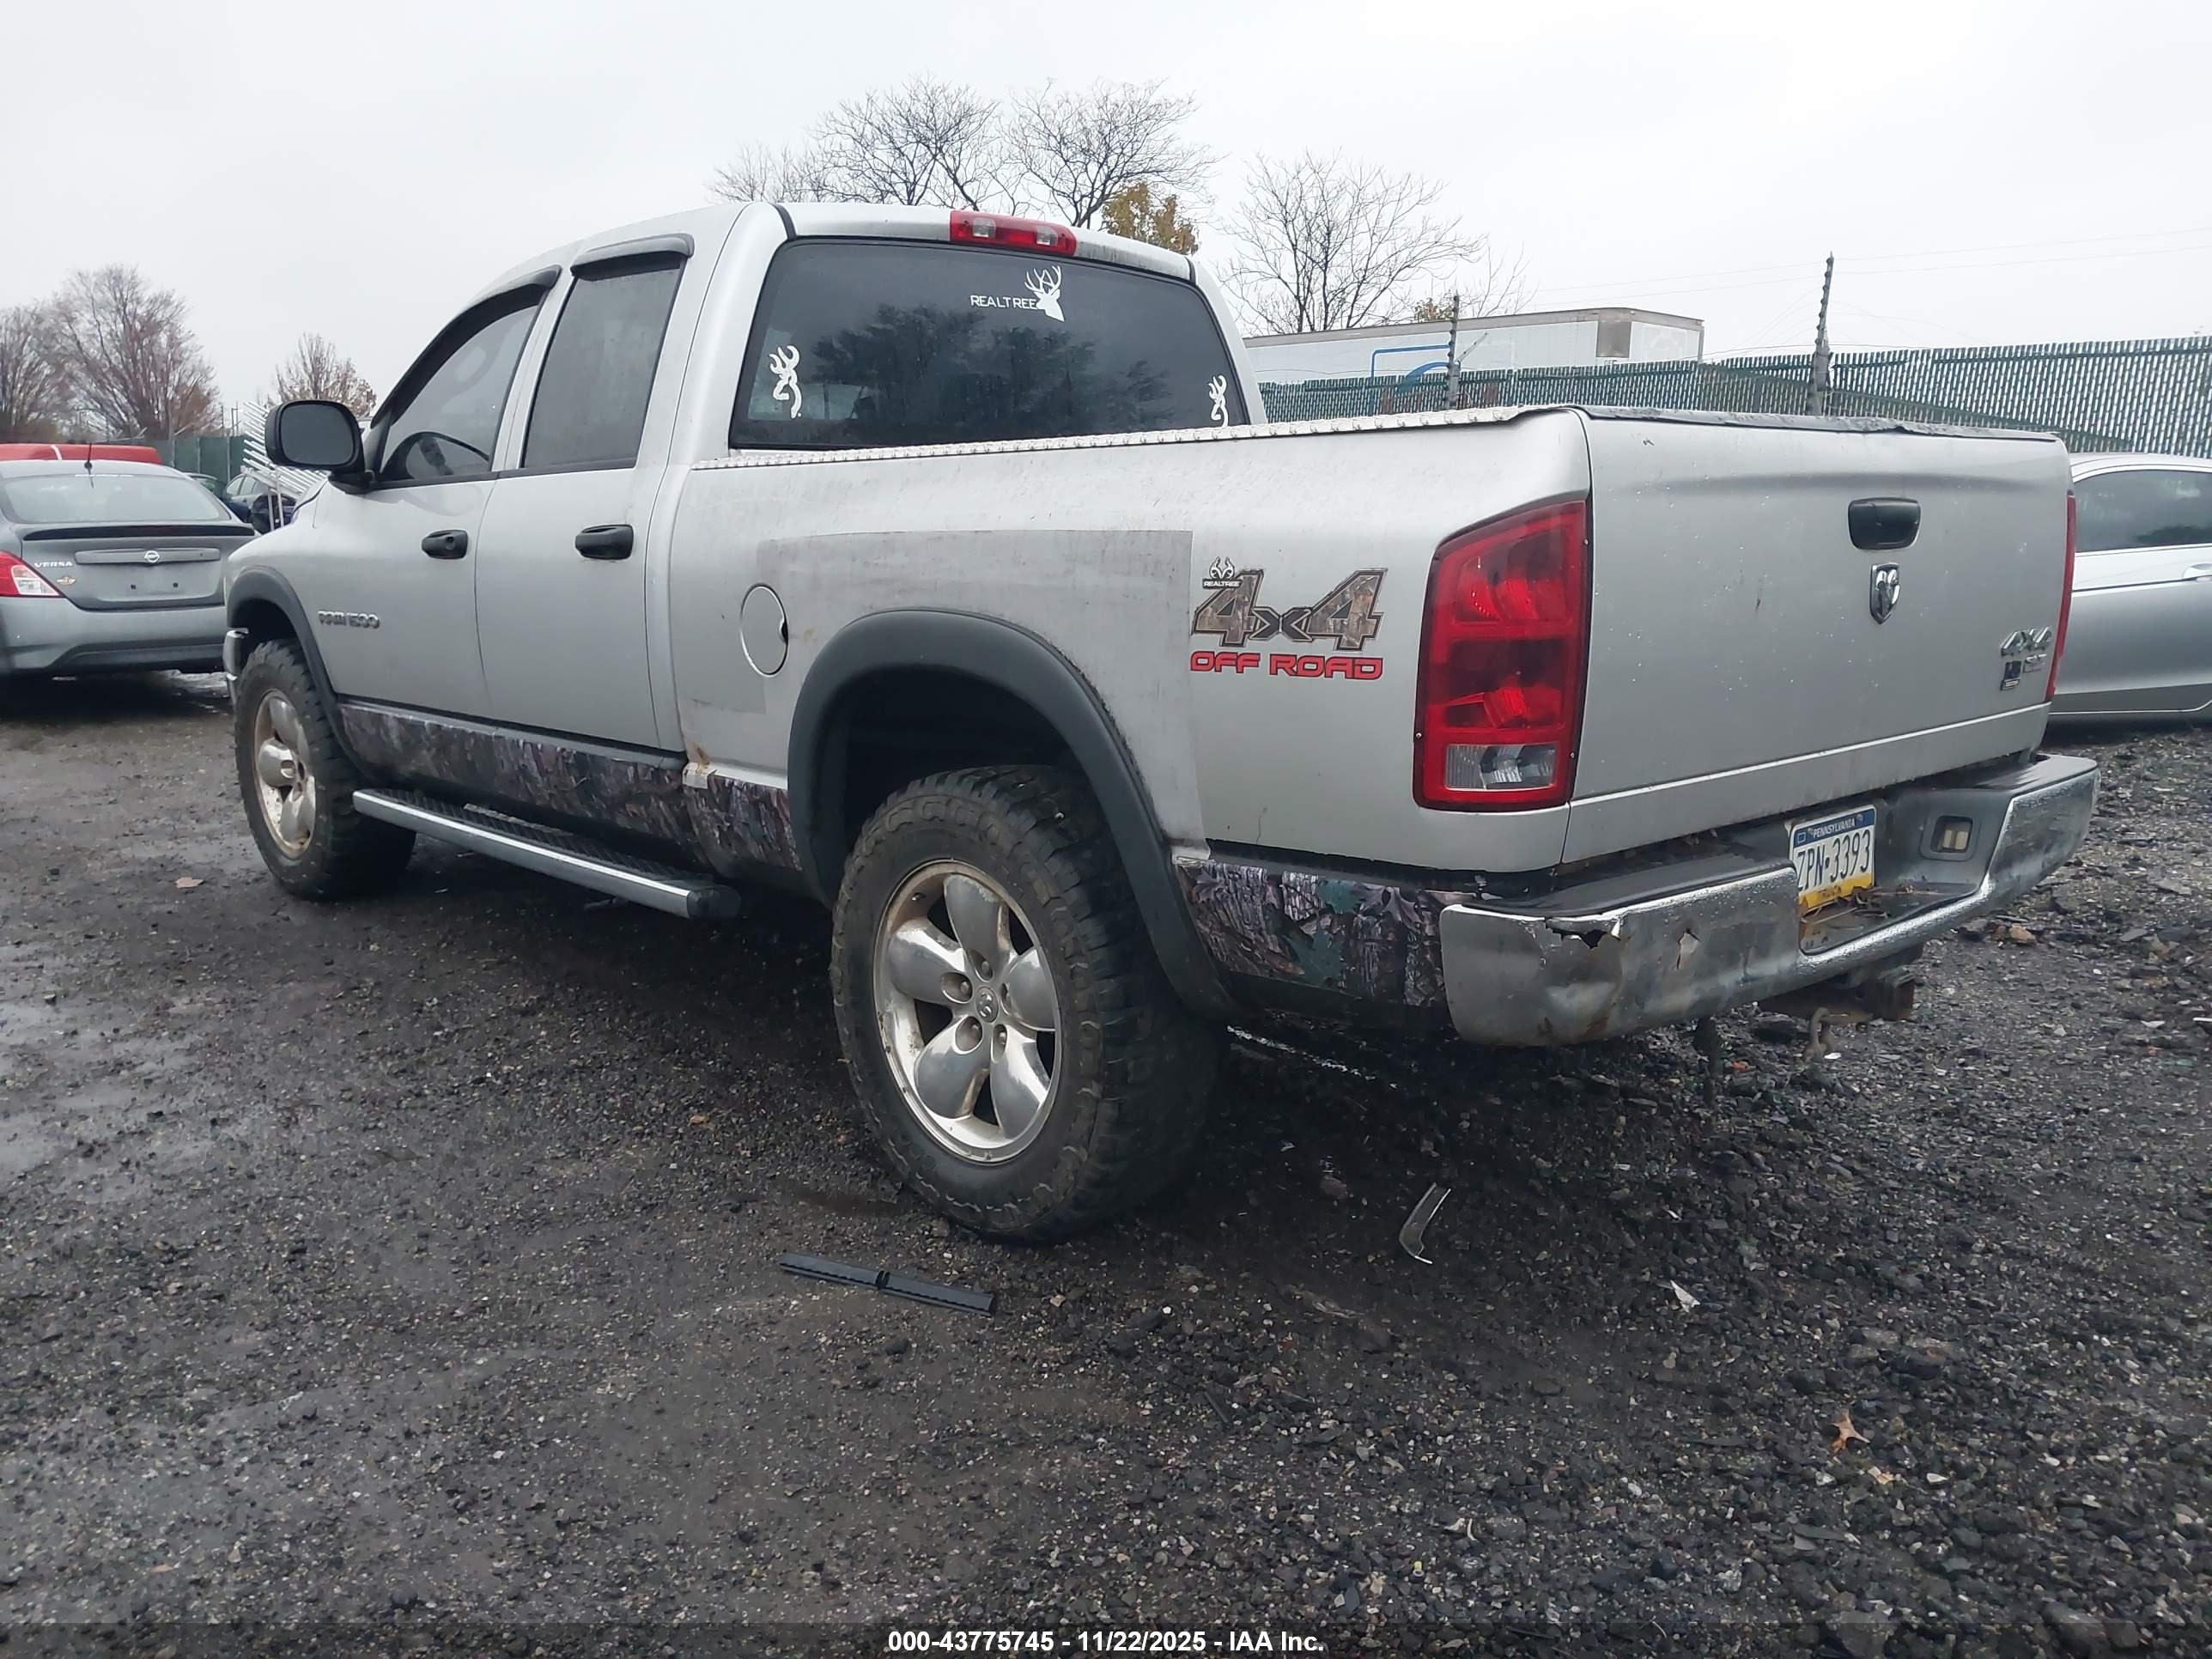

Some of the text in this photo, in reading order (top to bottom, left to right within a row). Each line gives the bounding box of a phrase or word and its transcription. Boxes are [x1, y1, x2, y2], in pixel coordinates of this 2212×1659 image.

[969, 295, 1037, 309] REALTREE
[1190, 650, 1383, 680] OFF ROAD
[1813, 817, 1856, 839] PENNSYLVANIA
